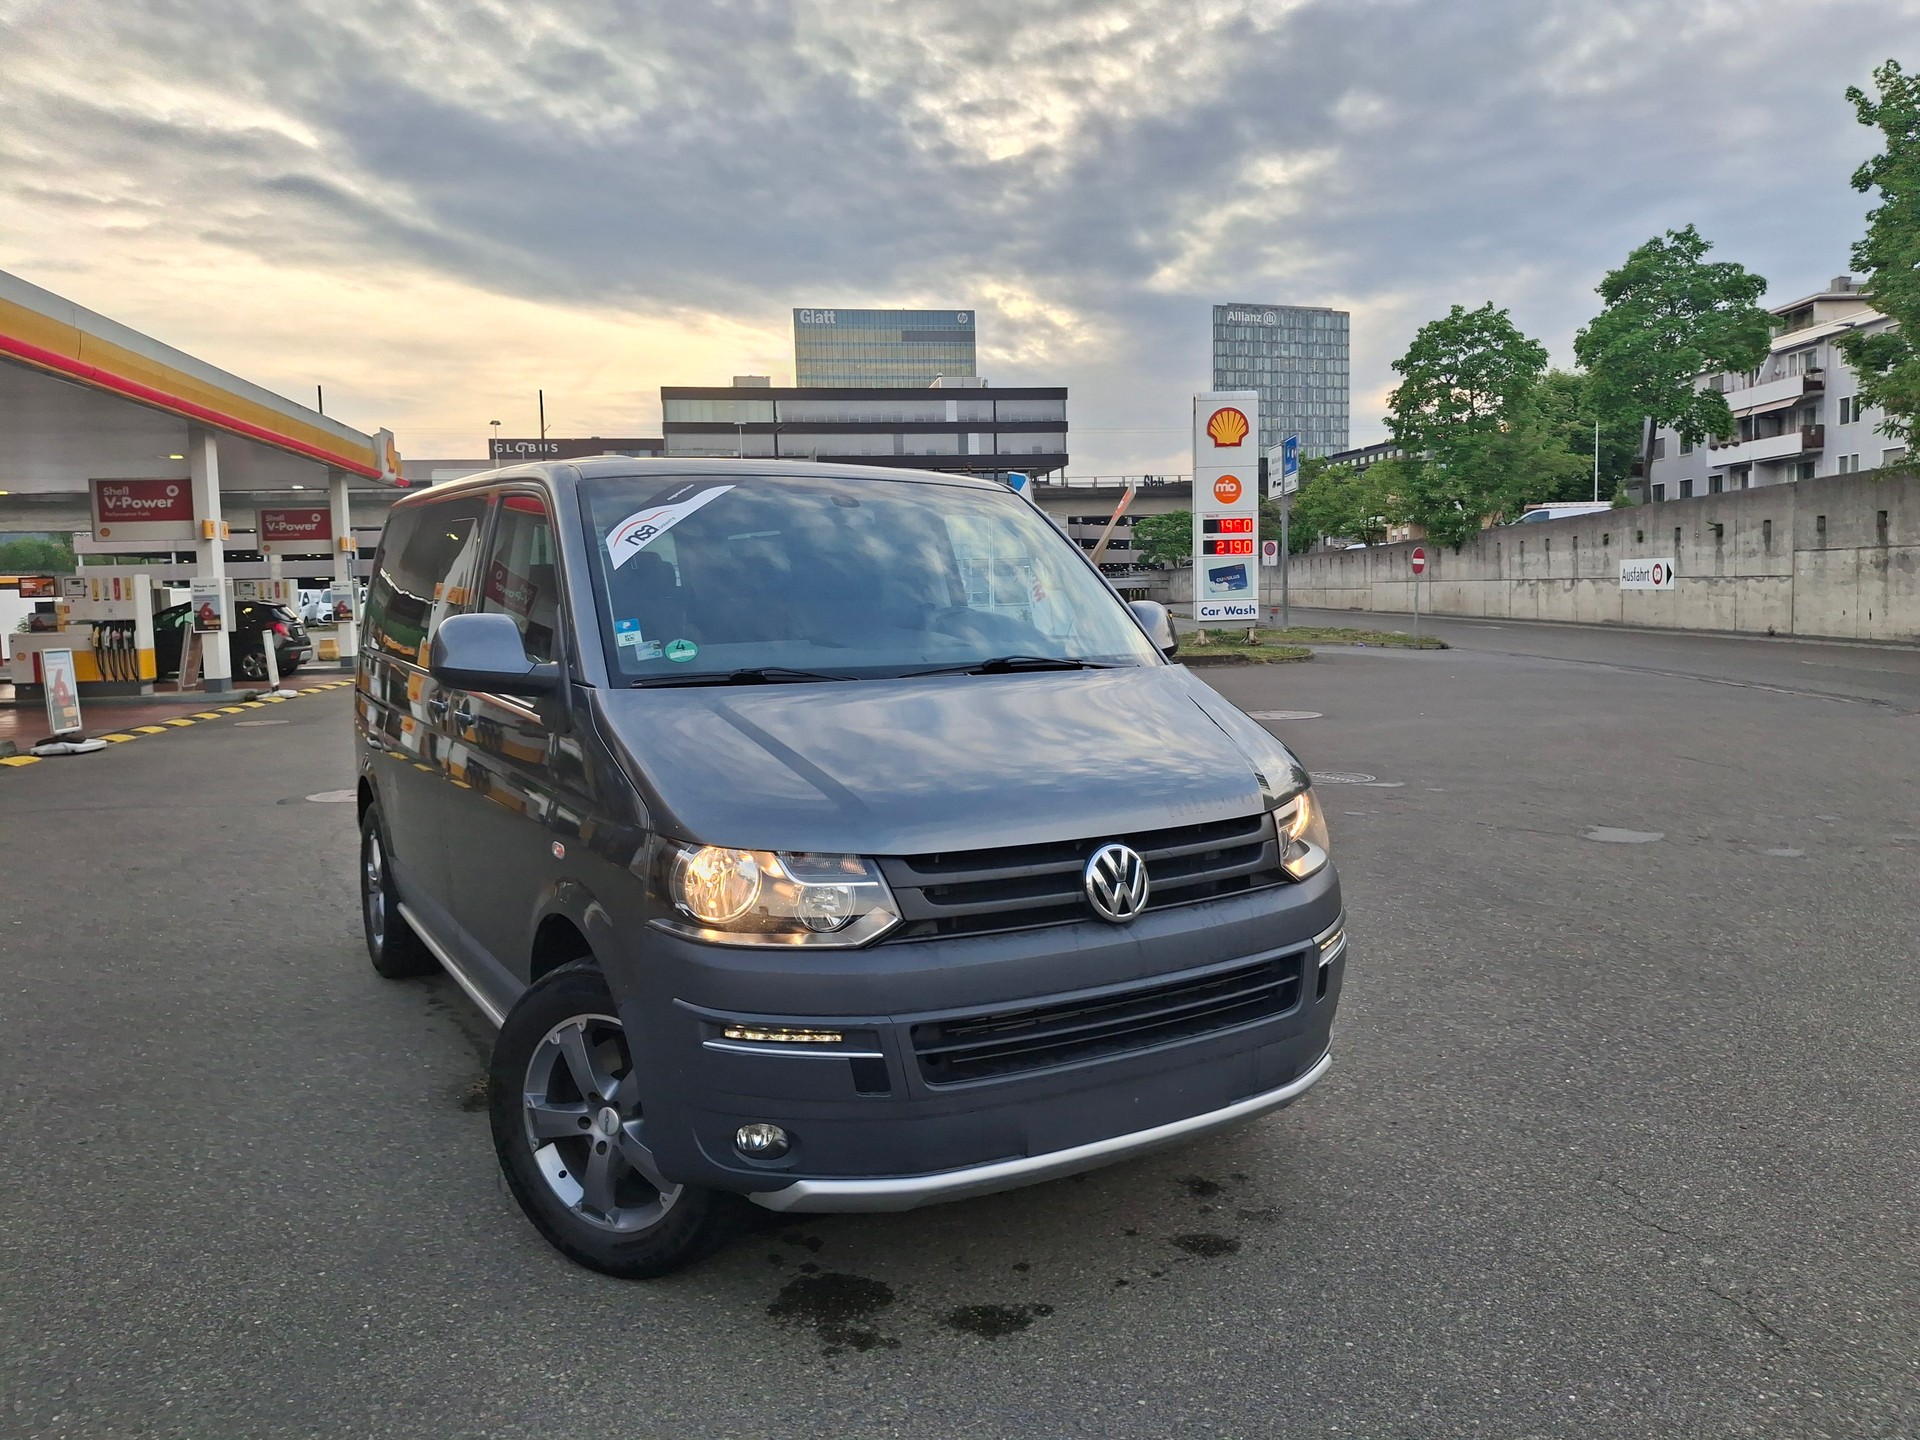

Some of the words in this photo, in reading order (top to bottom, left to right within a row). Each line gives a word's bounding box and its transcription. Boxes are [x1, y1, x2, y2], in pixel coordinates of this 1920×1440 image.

[800, 310, 836, 324] Glatt
[1227, 311, 1261, 322] Allianz
[494, 443, 558, 453] GLOBUS
[103, 486, 129, 496] Shell
[1215, 480, 1237, 492] mio
[104, 497, 174, 509] V-Power
[266, 522, 317, 531] V-Power
[624, 524, 659, 546] nsa
[1622, 566, 1650, 581] Ausfahrt
[1201, 606, 1221, 616] Car
[1224, 605, 1256, 615] Wash
[675, 640, 686, 650] 4
